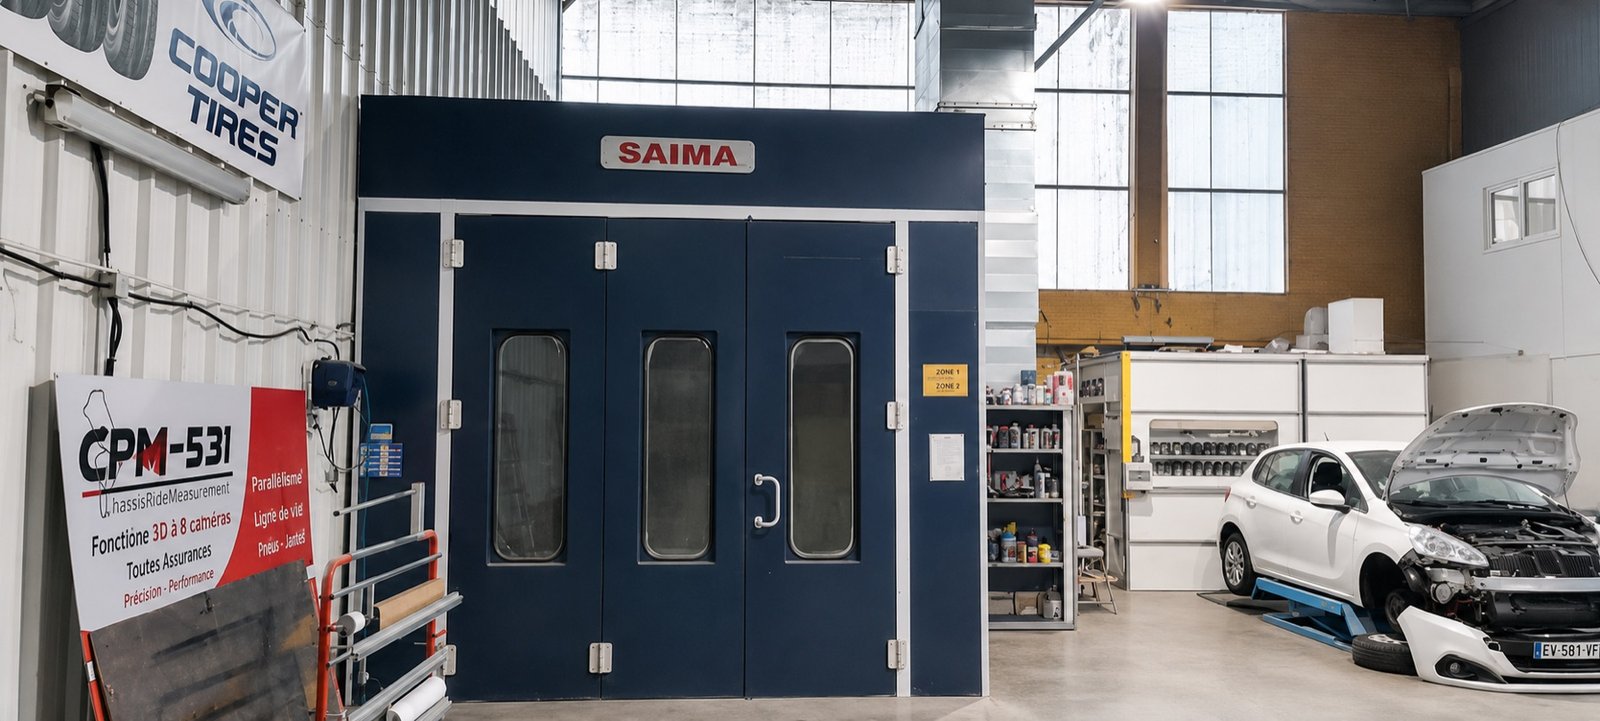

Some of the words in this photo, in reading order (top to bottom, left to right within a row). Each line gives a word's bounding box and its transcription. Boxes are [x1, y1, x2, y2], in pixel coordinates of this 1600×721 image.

[169, 28, 299, 139] COOPER
[187, 84, 279, 167] TIRES
[618, 141, 738, 167] SAIMA
[78, 425, 232, 483] CPM-531
[152, 522, 168, 542] 3D
[171, 519, 178, 538] à
[180, 517, 187, 535] 8
[189, 511, 232, 533] caméras
[254, 508, 277, 529] Ligne
[278, 505, 289, 521] de
[290, 503, 303, 518] vie
[258, 539, 279, 558] Pneus
[285, 531, 306, 549] Jantes
[127, 559, 161, 580] Toutes
[162, 544, 212, 571] Assurances
[124, 586, 162, 608] Précision
[168, 569, 215, 593] Performance
[1543, 644, 1599, 657] EV-581-VF
